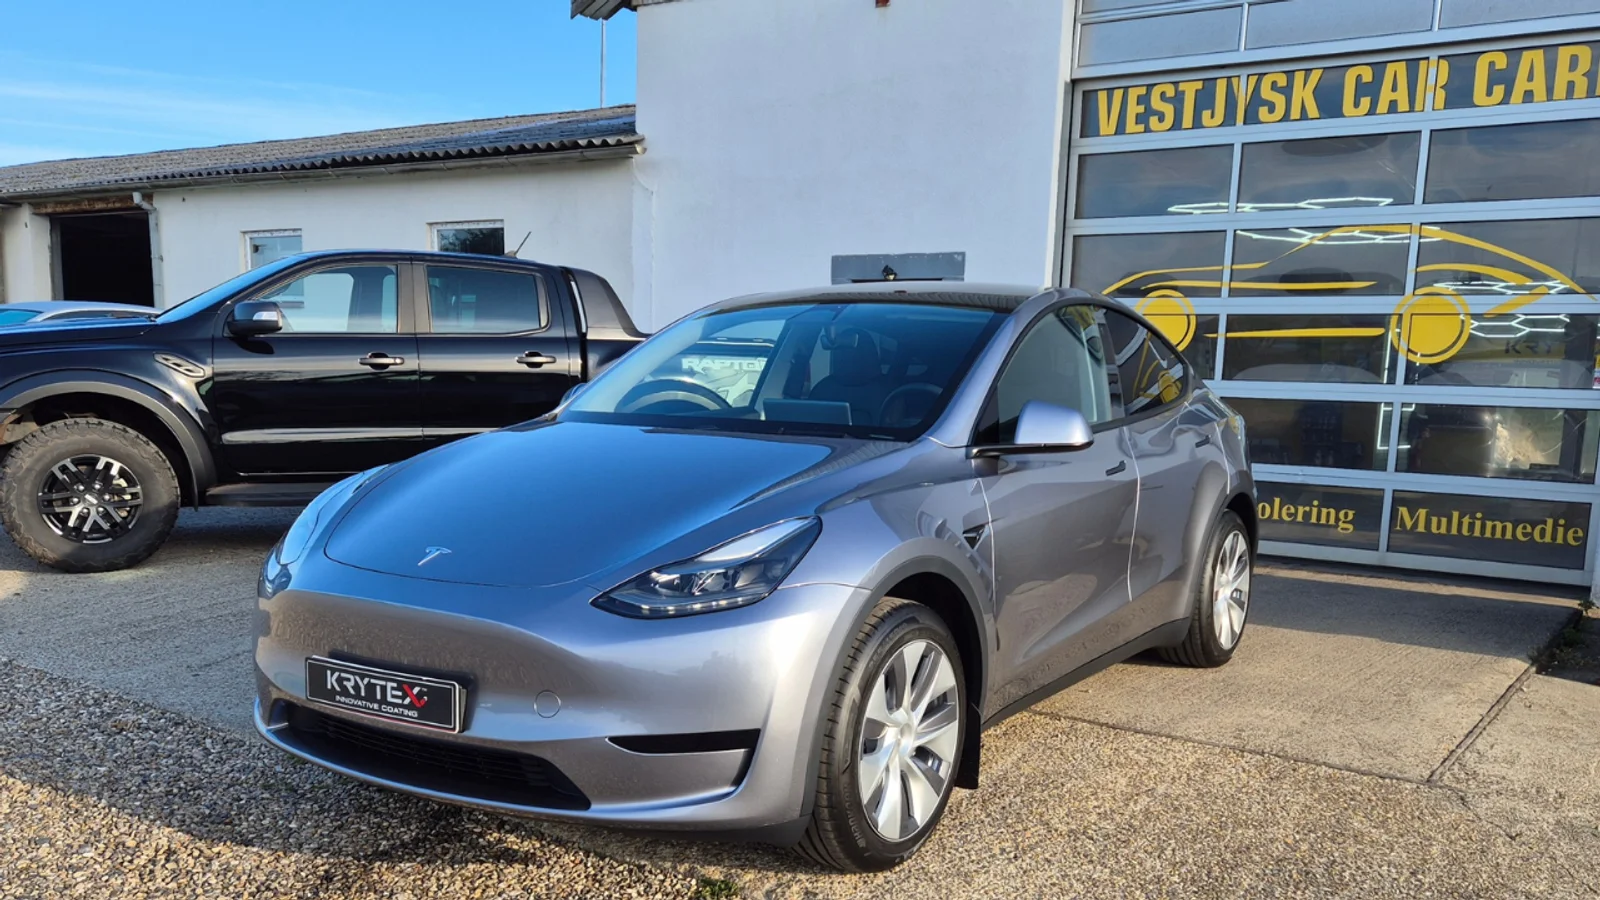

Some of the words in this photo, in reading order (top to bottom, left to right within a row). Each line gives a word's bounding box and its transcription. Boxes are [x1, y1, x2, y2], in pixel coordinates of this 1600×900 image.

[1097, 68, 1323, 136] VESTJYSK
[1342, 57, 1450, 117] CAR
[1472, 45, 1600, 107] CAR
[1256, 497, 1355, 534] olering
[1394, 505, 1584, 546] Multimedie
[327, 670, 428, 708] KRYTEX
[335, 695, 381, 710] INNOVATIVE
[382, 705, 418, 718] COATING
